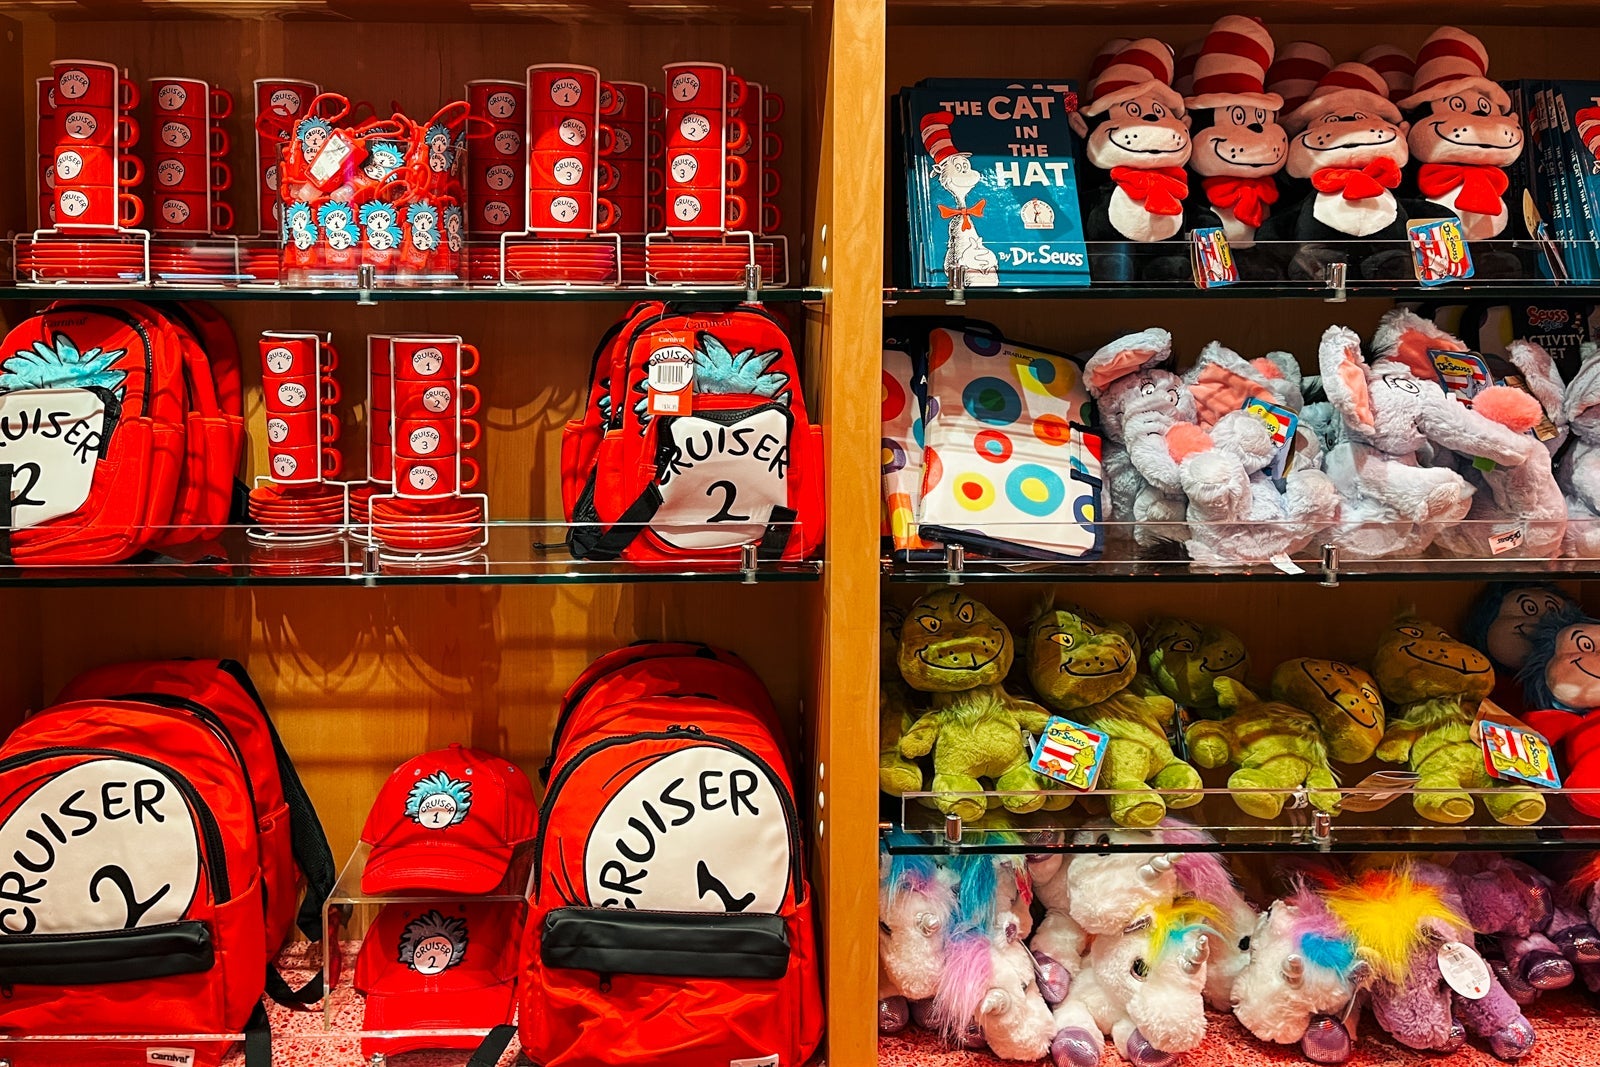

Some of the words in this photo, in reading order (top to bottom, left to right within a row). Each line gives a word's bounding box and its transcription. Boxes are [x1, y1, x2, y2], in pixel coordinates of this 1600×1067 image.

[60, 74, 88, 87] CRUISER
[673, 77, 699, 90] CRUISER
[70, 85, 77, 95] 1
[159, 88, 185, 101] CRUISER
[552, 82, 581, 96] CRUISER
[682, 88, 688, 98] 1
[168, 98, 174, 107] 1
[271, 93, 299, 106] CRUISER
[489, 96, 516, 108] CRUISER
[563, 93, 570, 103] 1
[499, 106, 505, 115] 1
[939, 101, 983, 116] THE
[987, 95, 1055, 121] CAT
[67, 115, 95, 130] CRUISER
[683, 117, 709, 134] CRUISER
[74, 126, 82, 134] 2
[163, 125, 190, 141] CRUISER
[562, 122, 585, 139] CRUISER
[688, 127, 697, 138] 2
[1015, 125, 1039, 139] IN
[170, 135, 177, 143] 2
[568, 132, 575, 142] 2
[505, 142, 511, 151] 2
[1008, 143, 1049, 158] THE
[64, 166, 70, 175] 3
[158, 162, 184, 175] CRUISER
[555, 161, 583, 174] CRUISER
[673, 158, 697, 171] CRUISER
[1572, 163, 1580, 178] CAT
[167, 173, 173, 182] 3
[487, 168, 514, 179] CRUISER
[565, 171, 572, 181] 3
[679, 169, 686, 179] 3
[995, 161, 1069, 187] HAT
[498, 177, 504, 186] 3
[1576, 179, 1582, 188] IN
[62, 194, 86, 209] CRUISER
[1579, 189, 1587, 203] THE
[69, 203, 74, 212] 4
[163, 203, 188, 218] CRUISER
[552, 199, 577, 215] CRUISER
[675, 198, 699, 213] CRUISER
[1582, 203, 1592, 220] HAT
[325, 212, 347, 225] CRUISER
[368, 212, 390, 224] CRUISER
[414, 213, 433, 225] CRUISER
[560, 209, 566, 218] 4
[377, 221, 382, 229] 1
[421, 222, 426, 230] 1
[998, 250, 1011, 262] By
[1009, 246, 1039, 267] Dr.
[1039, 244, 1084, 267] Seuss
[1526, 305, 1569, 326] Seuss
[685, 317, 733, 331] Carnival
[268, 351, 292, 363] CRUISER
[413, 352, 442, 364] CRUISER
[649, 349, 694, 369] CRUISER
[1545, 347, 1566, 359] ET
[277, 361, 283, 370] 1
[425, 362, 432, 371] 1
[280, 385, 305, 400] CRUISER
[286, 394, 294, 403] 2
[425, 390, 450, 403] CRUISER
[433, 399, 441, 408] 2
[273, 430, 278, 439] 3
[411, 431, 439, 443] CRUISER
[421, 441, 428, 450] 3
[410, 470, 436, 483] CRUISER
[418, 478, 424, 486] 4
[11, 462, 46, 506] 2
[705, 480, 751, 523] 2
[1062, 732, 1086, 747] Seuss
[420, 798, 455, 815] CRUISER
[432, 811, 440, 824] 1
[0, 778, 166, 936] CRUISER
[696, 860, 757, 914] 1
[89, 864, 171, 929] 2
[415, 941, 451, 959] CRUISER
[427, 955, 439, 969] 2
[150, 1050, 191, 1065] Carnival
